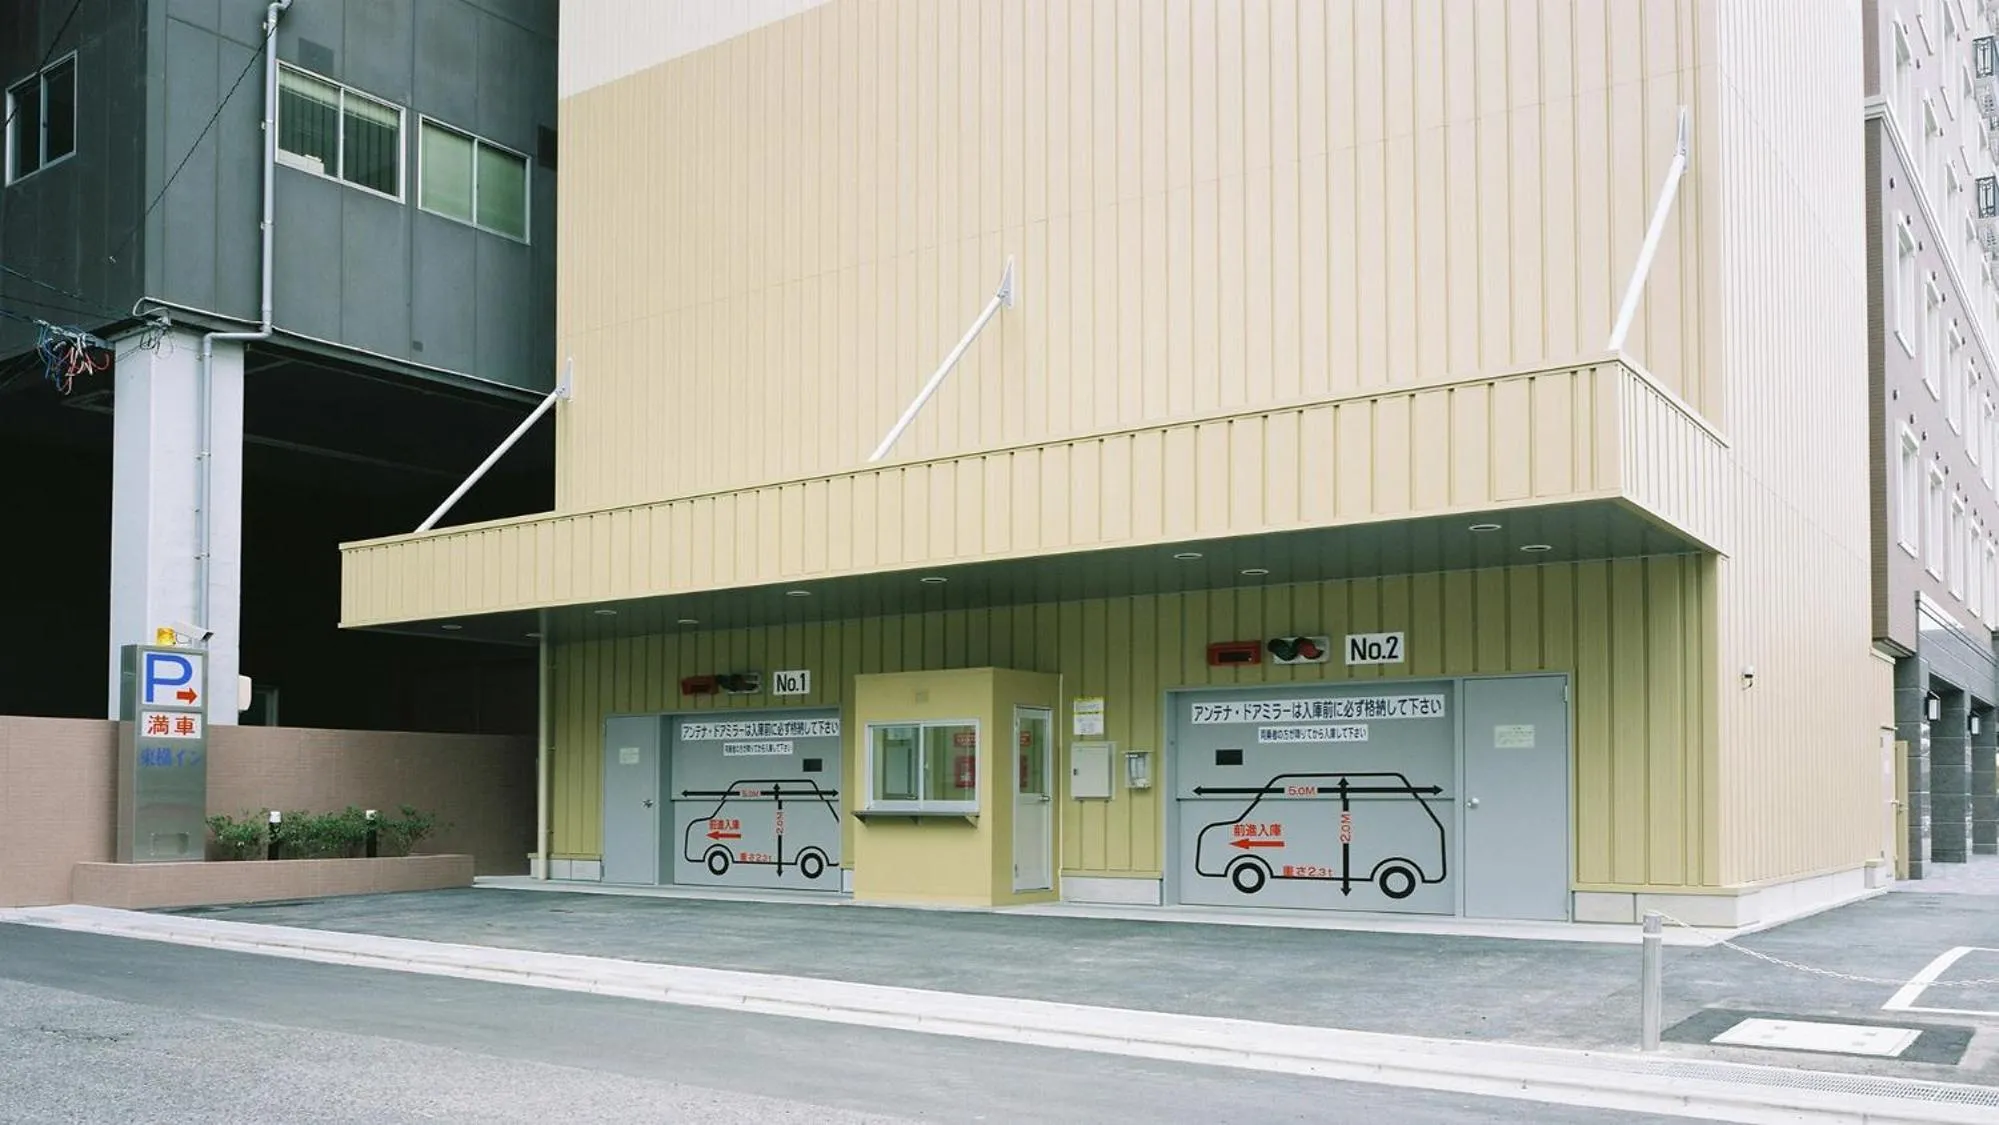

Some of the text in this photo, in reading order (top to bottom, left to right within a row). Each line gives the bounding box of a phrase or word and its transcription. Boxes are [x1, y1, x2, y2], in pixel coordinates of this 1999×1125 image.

[1350, 636, 1399, 661] No.2
[146, 653, 193, 703] P
[776, 672, 806, 692] No.1
[1193, 698, 1442, 722] アンテナ・ドアミラーは入庫前に必ず格納して下さい
[147, 715, 196, 736] 満車
[1233, 824, 1282, 837] 前進入庫
